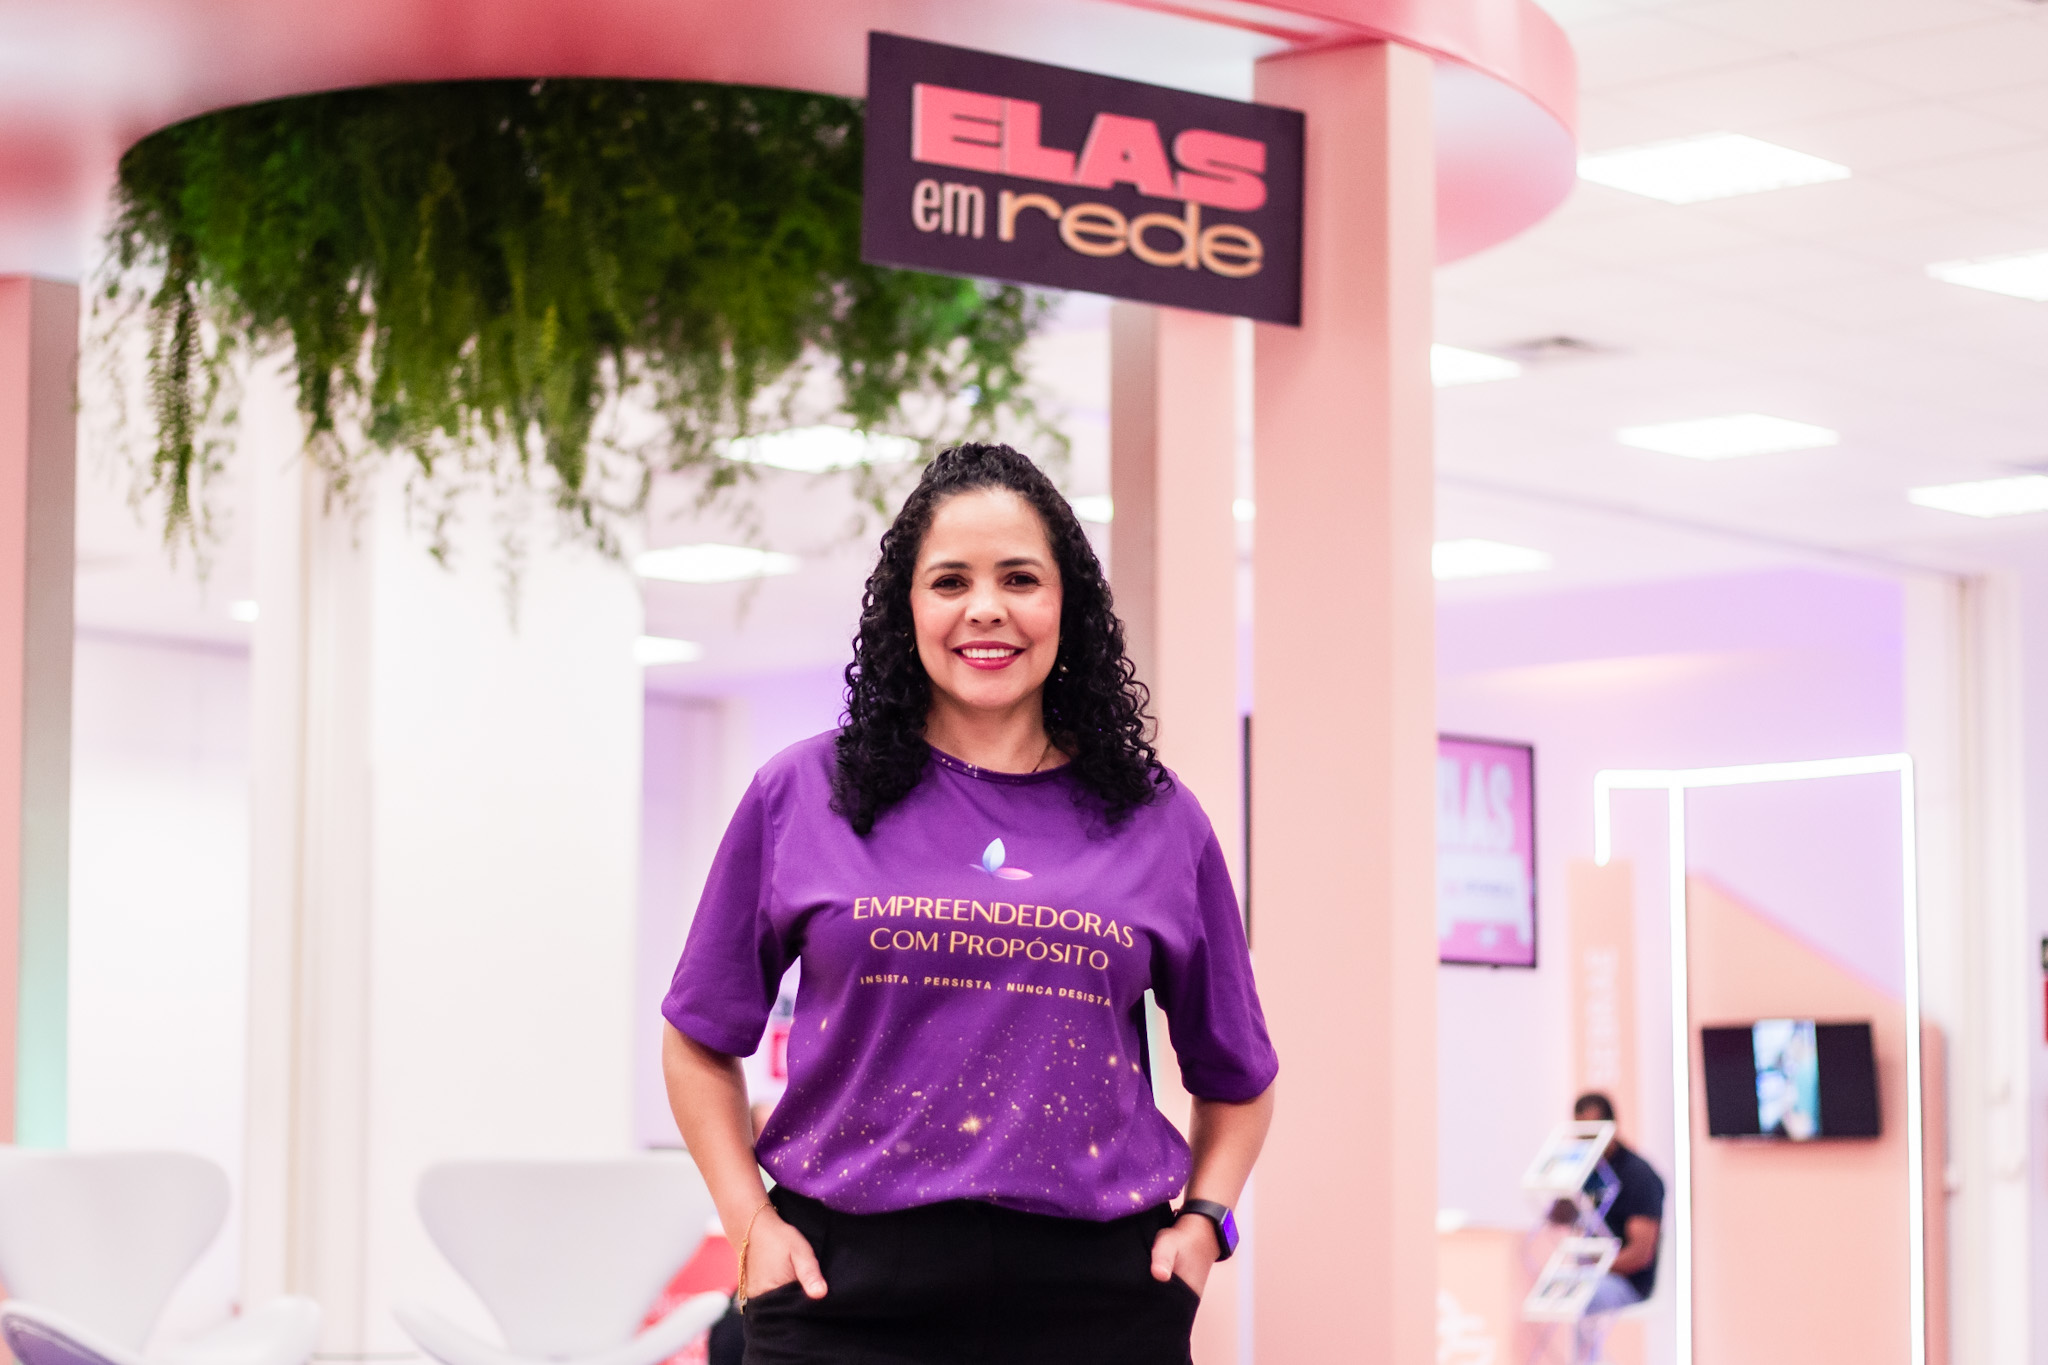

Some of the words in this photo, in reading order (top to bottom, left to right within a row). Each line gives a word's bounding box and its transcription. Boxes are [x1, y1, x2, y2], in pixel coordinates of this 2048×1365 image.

[912, 82, 1267, 212] ELAS
[912, 179, 985, 239] em
[999, 189, 1264, 278] rede
[852, 895, 1134, 949] EMPREENDEDORAS
[869, 927, 940, 953] COM
[949, 930, 1110, 971] PROPÓSITO
[860, 973, 909, 986] INSISTA
[923, 976, 992, 990] PERSISTA
[1006, 982, 1053, 997] NUNCA
[1058, 987, 1113, 1008] DESISTA
